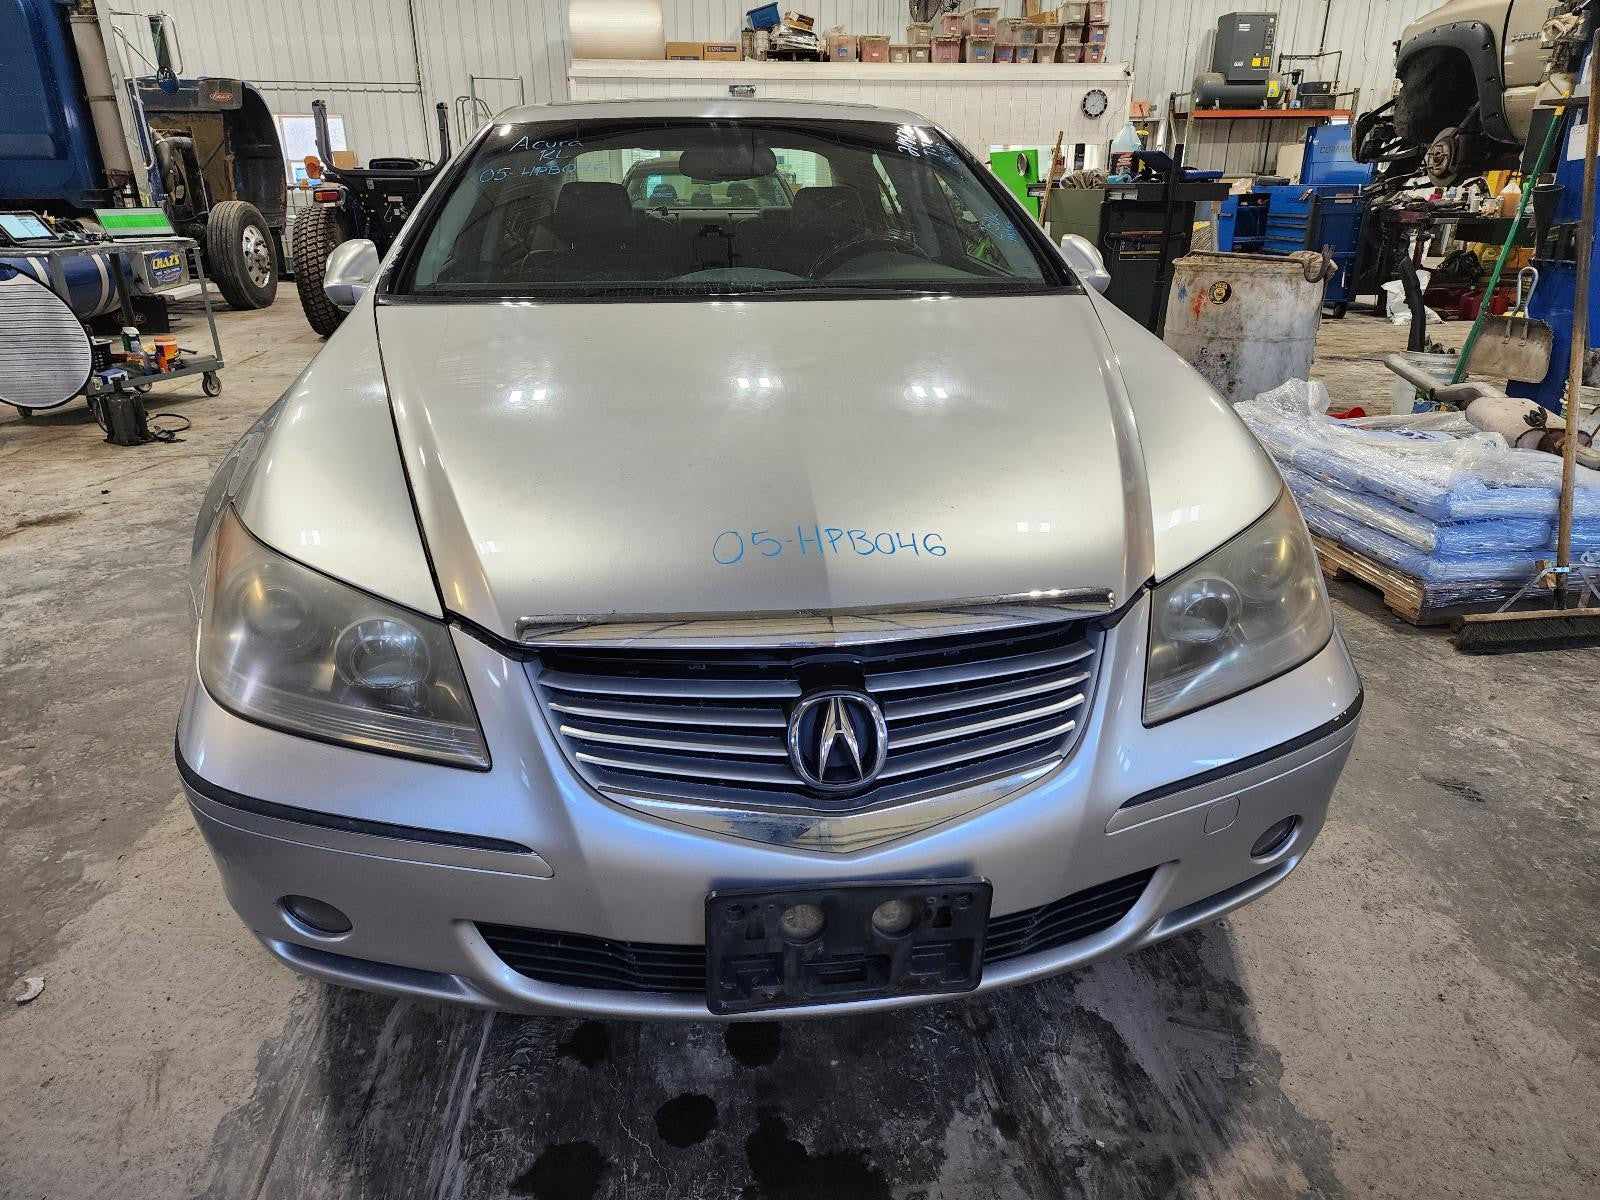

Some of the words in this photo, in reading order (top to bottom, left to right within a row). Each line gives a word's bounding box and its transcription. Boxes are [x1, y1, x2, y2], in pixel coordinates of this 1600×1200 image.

[509, 135, 584, 151] Acura
[479, 163, 609, 183] 05-HPB0
[712, 525, 947, 565] 05-HPB046
